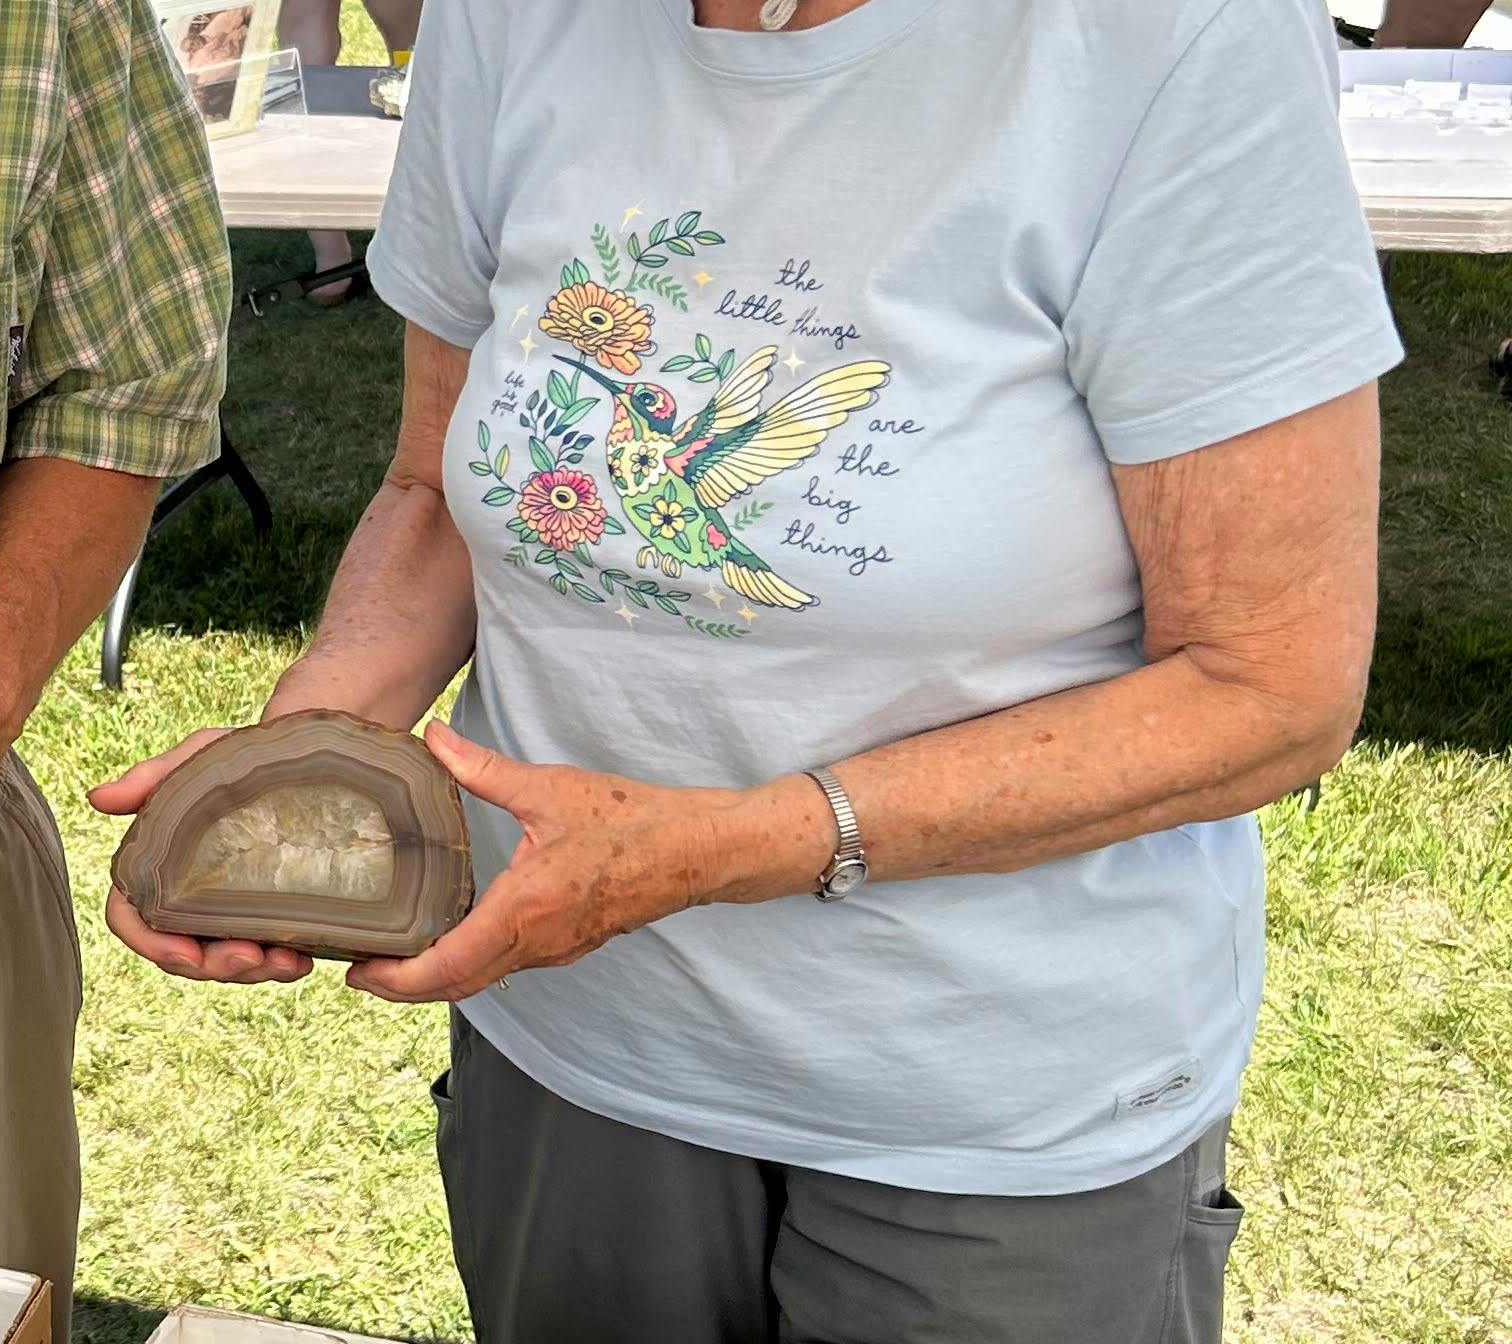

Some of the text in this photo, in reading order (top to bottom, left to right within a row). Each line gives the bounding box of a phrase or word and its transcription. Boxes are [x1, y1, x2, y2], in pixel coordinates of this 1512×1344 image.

[774, 258, 825, 292] the
[714, 290, 862, 350] little things
[868, 415, 925, 436] are
[834, 444, 900, 478] the
[801, 479, 862, 524] big
[780, 520, 895, 576] things
